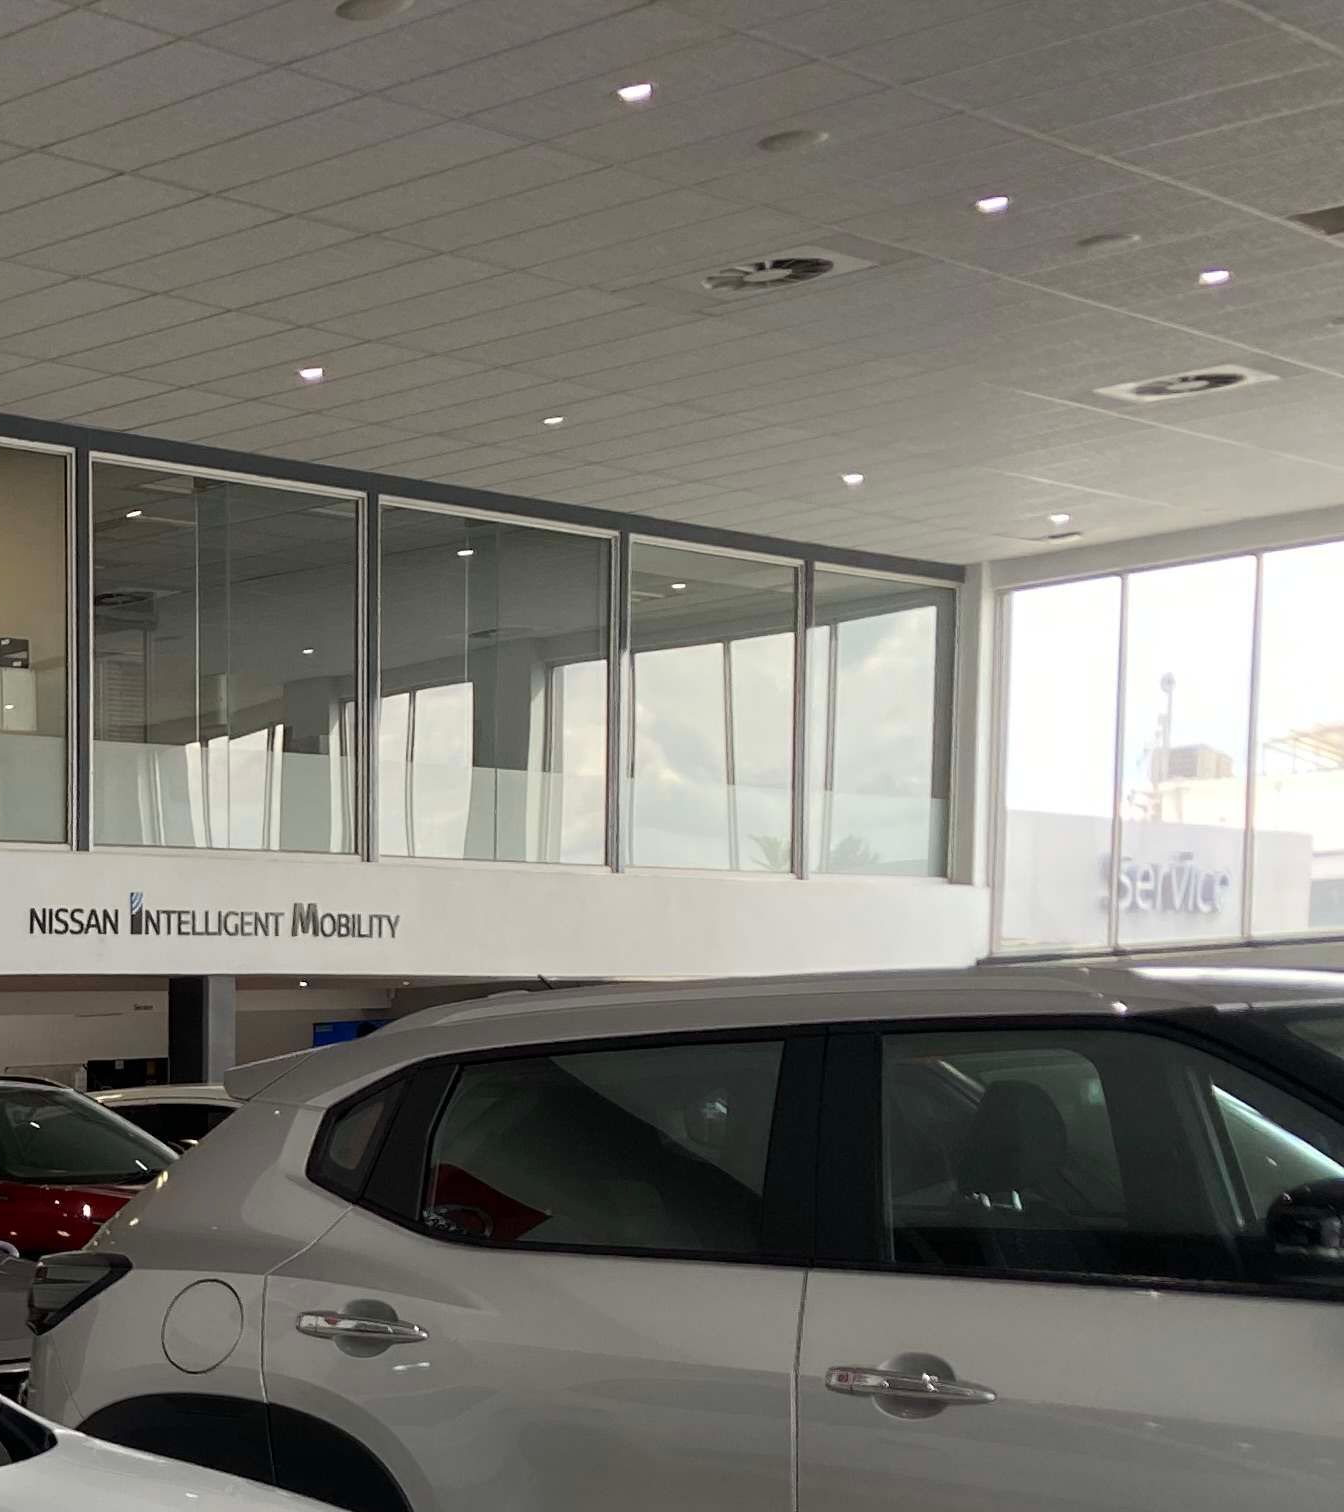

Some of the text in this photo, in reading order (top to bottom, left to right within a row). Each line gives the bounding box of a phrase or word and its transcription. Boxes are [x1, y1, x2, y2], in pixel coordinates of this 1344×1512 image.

[29, 891, 401, 939] NISSAN INTELLIGENT MOBILITY
